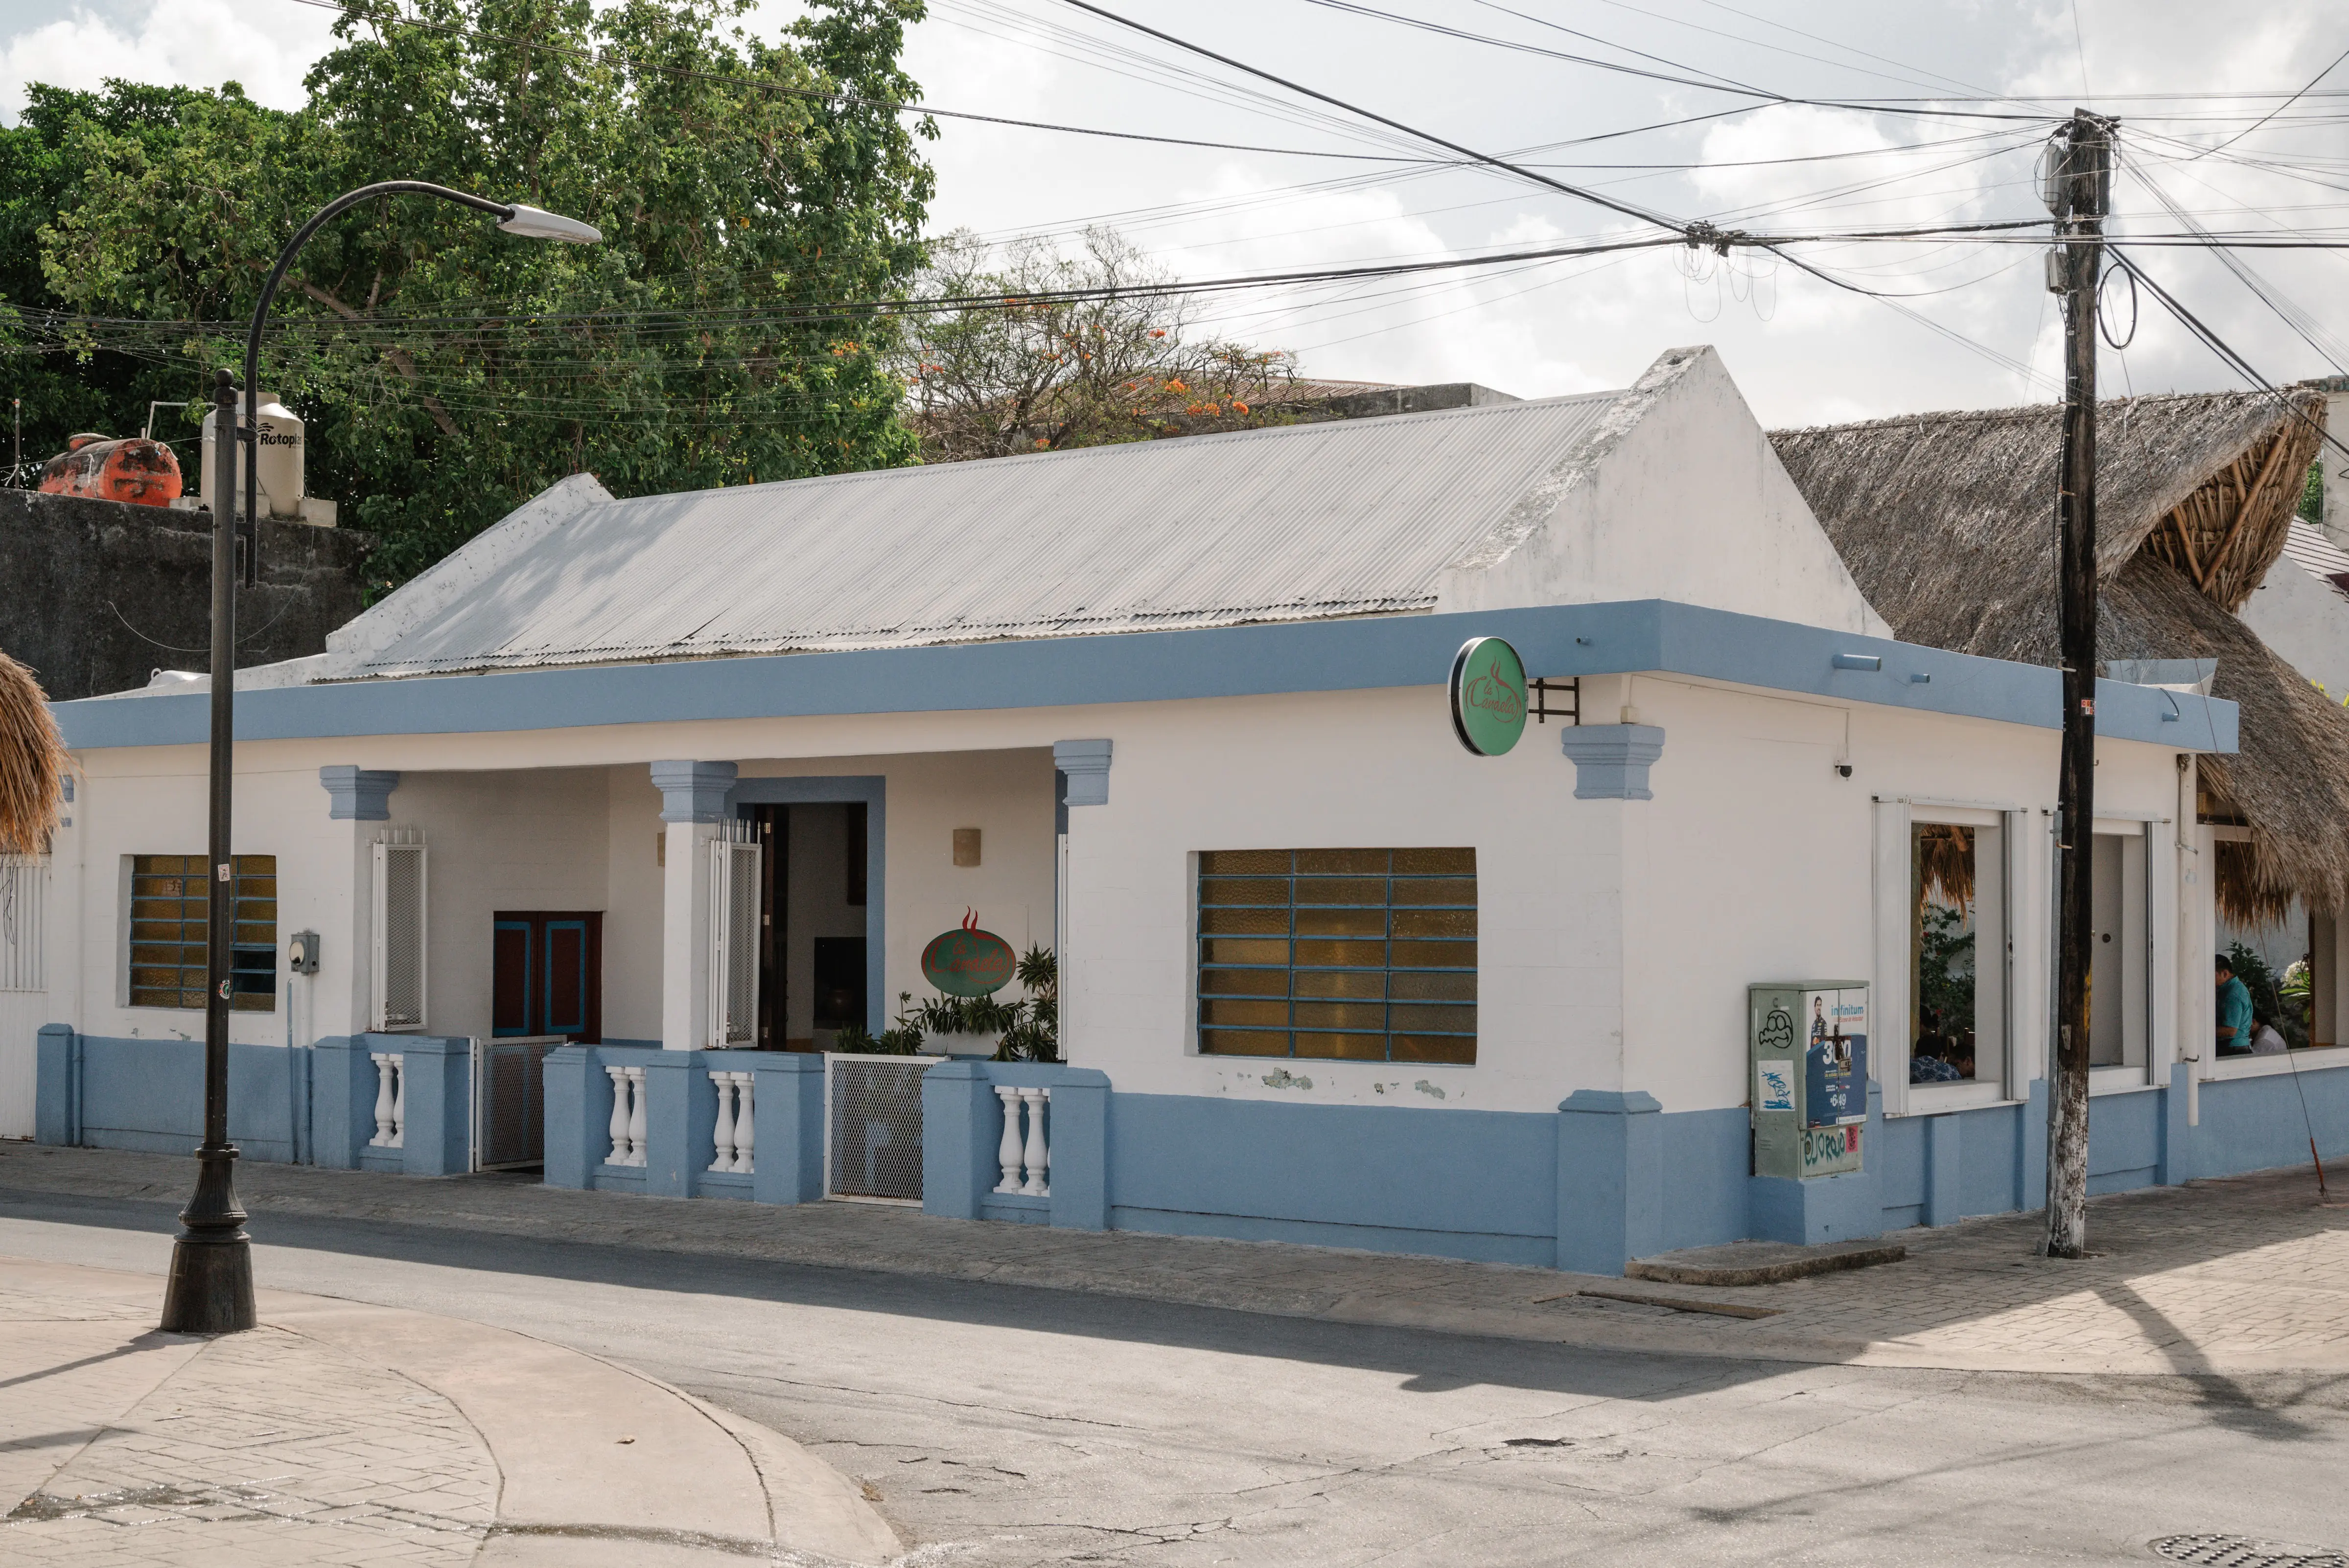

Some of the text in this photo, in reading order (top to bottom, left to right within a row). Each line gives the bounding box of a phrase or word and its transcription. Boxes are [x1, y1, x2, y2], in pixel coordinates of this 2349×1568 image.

[1470, 676, 1515, 715] Candela
[930, 933, 1005, 973] Candela
[1831, 1004, 1863, 1016] infinitum
